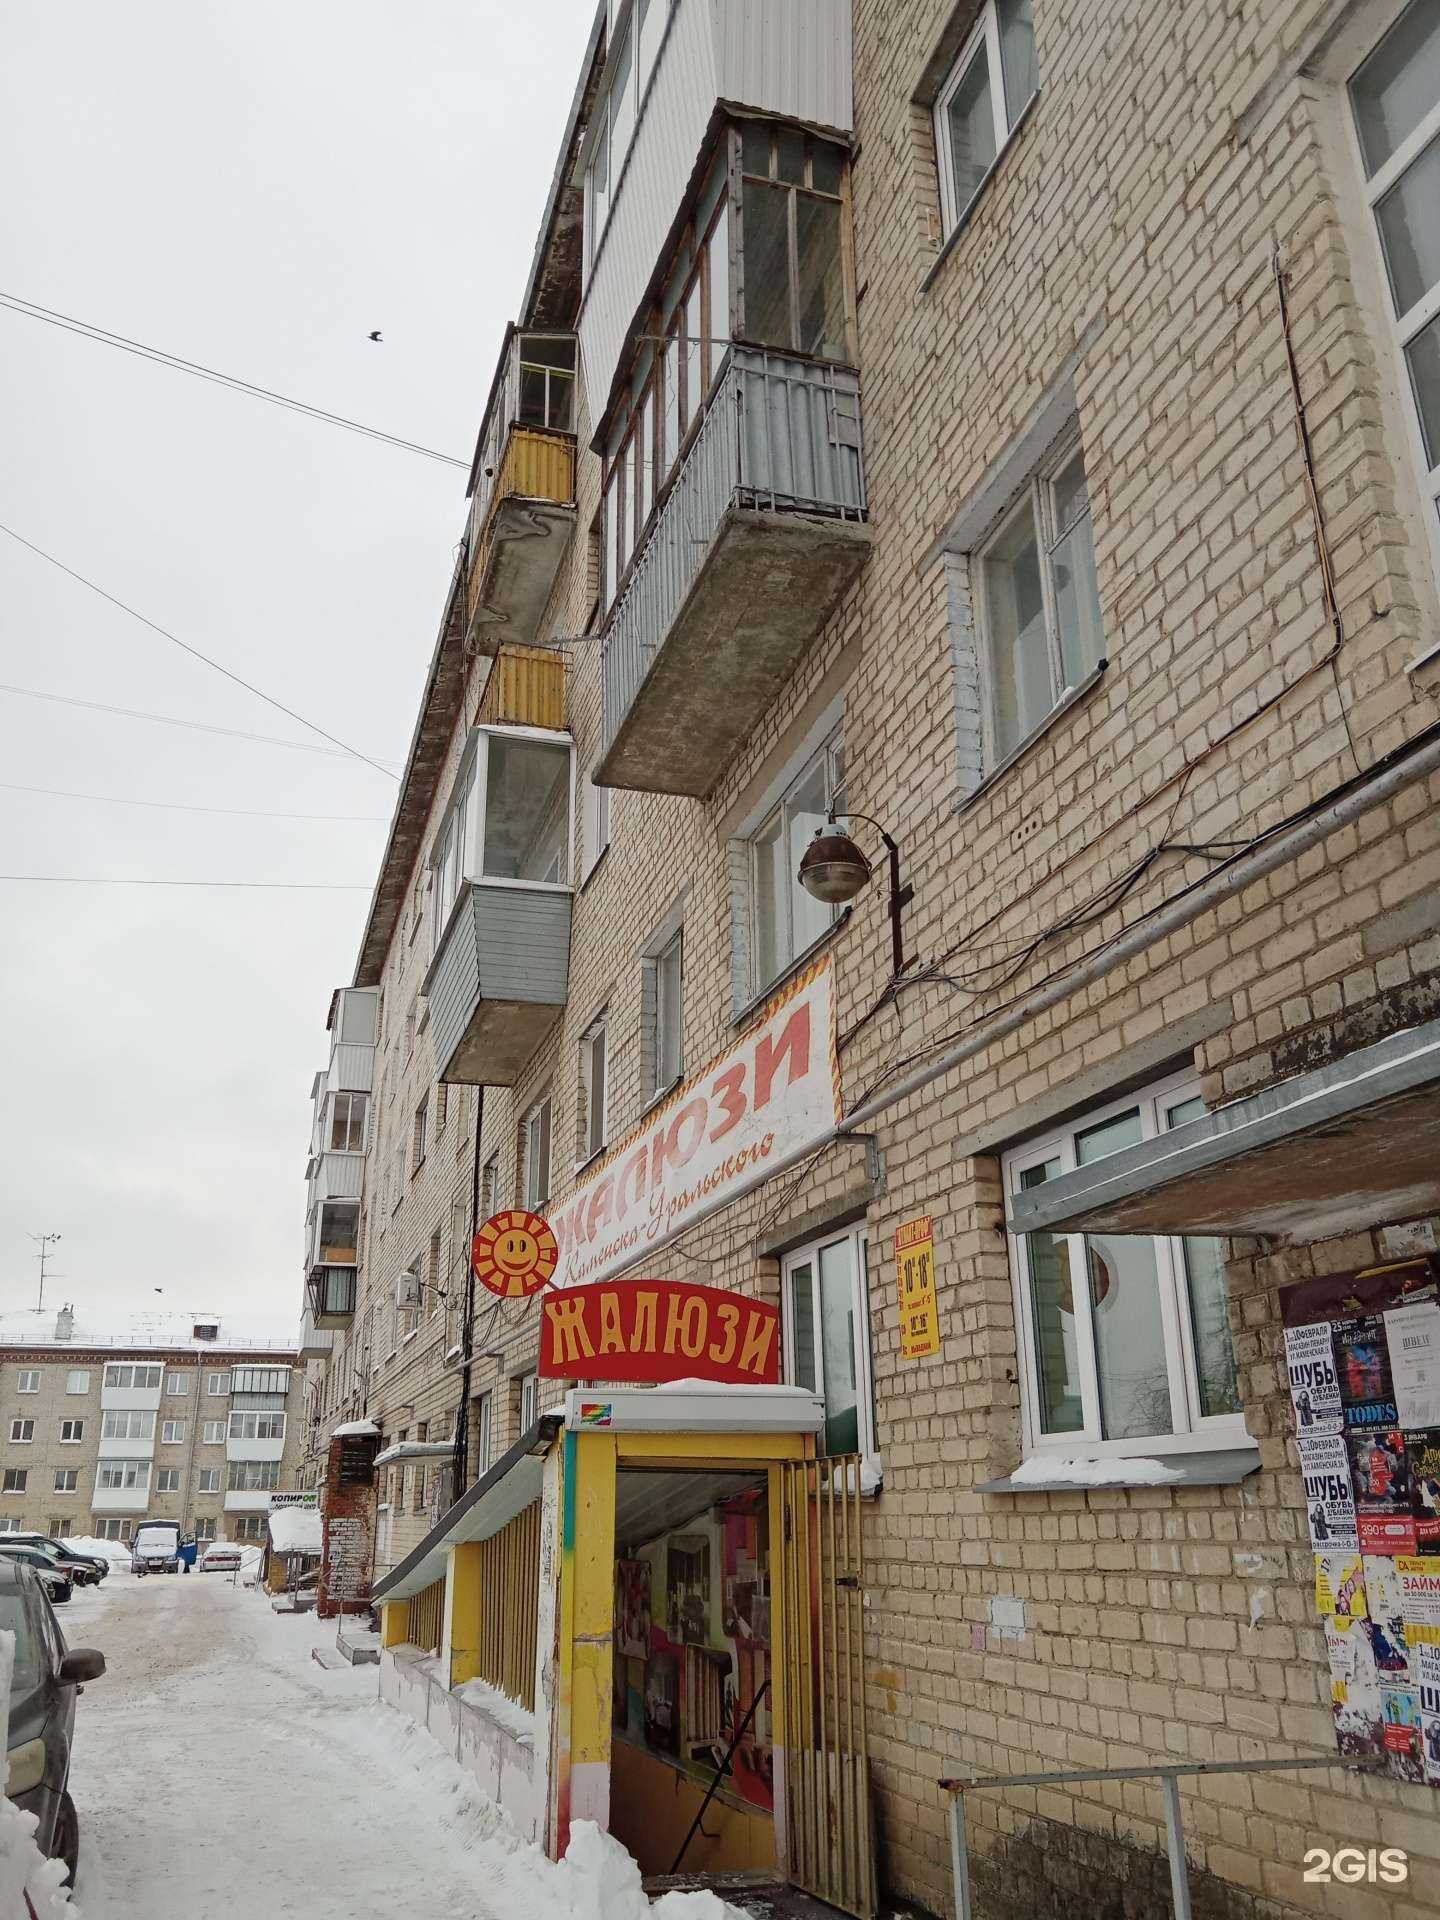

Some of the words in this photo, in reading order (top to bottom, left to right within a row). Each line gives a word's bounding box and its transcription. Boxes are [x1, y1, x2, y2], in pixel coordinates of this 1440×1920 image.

[554, 1001, 810, 1256] ЖАЛЮЗИ
[545, 1291, 777, 1375] ЖАЛЮЗИ
[1310, 1385, 1339, 1395] ОБУВЬ
[1345, 1402, 1397, 1424] TODES
[1325, 1501, 1353, 1510] ОБУВЬ
[1361, 1524, 1380, 1536] 390
[1430, 1646, 1440, 1661] 10
